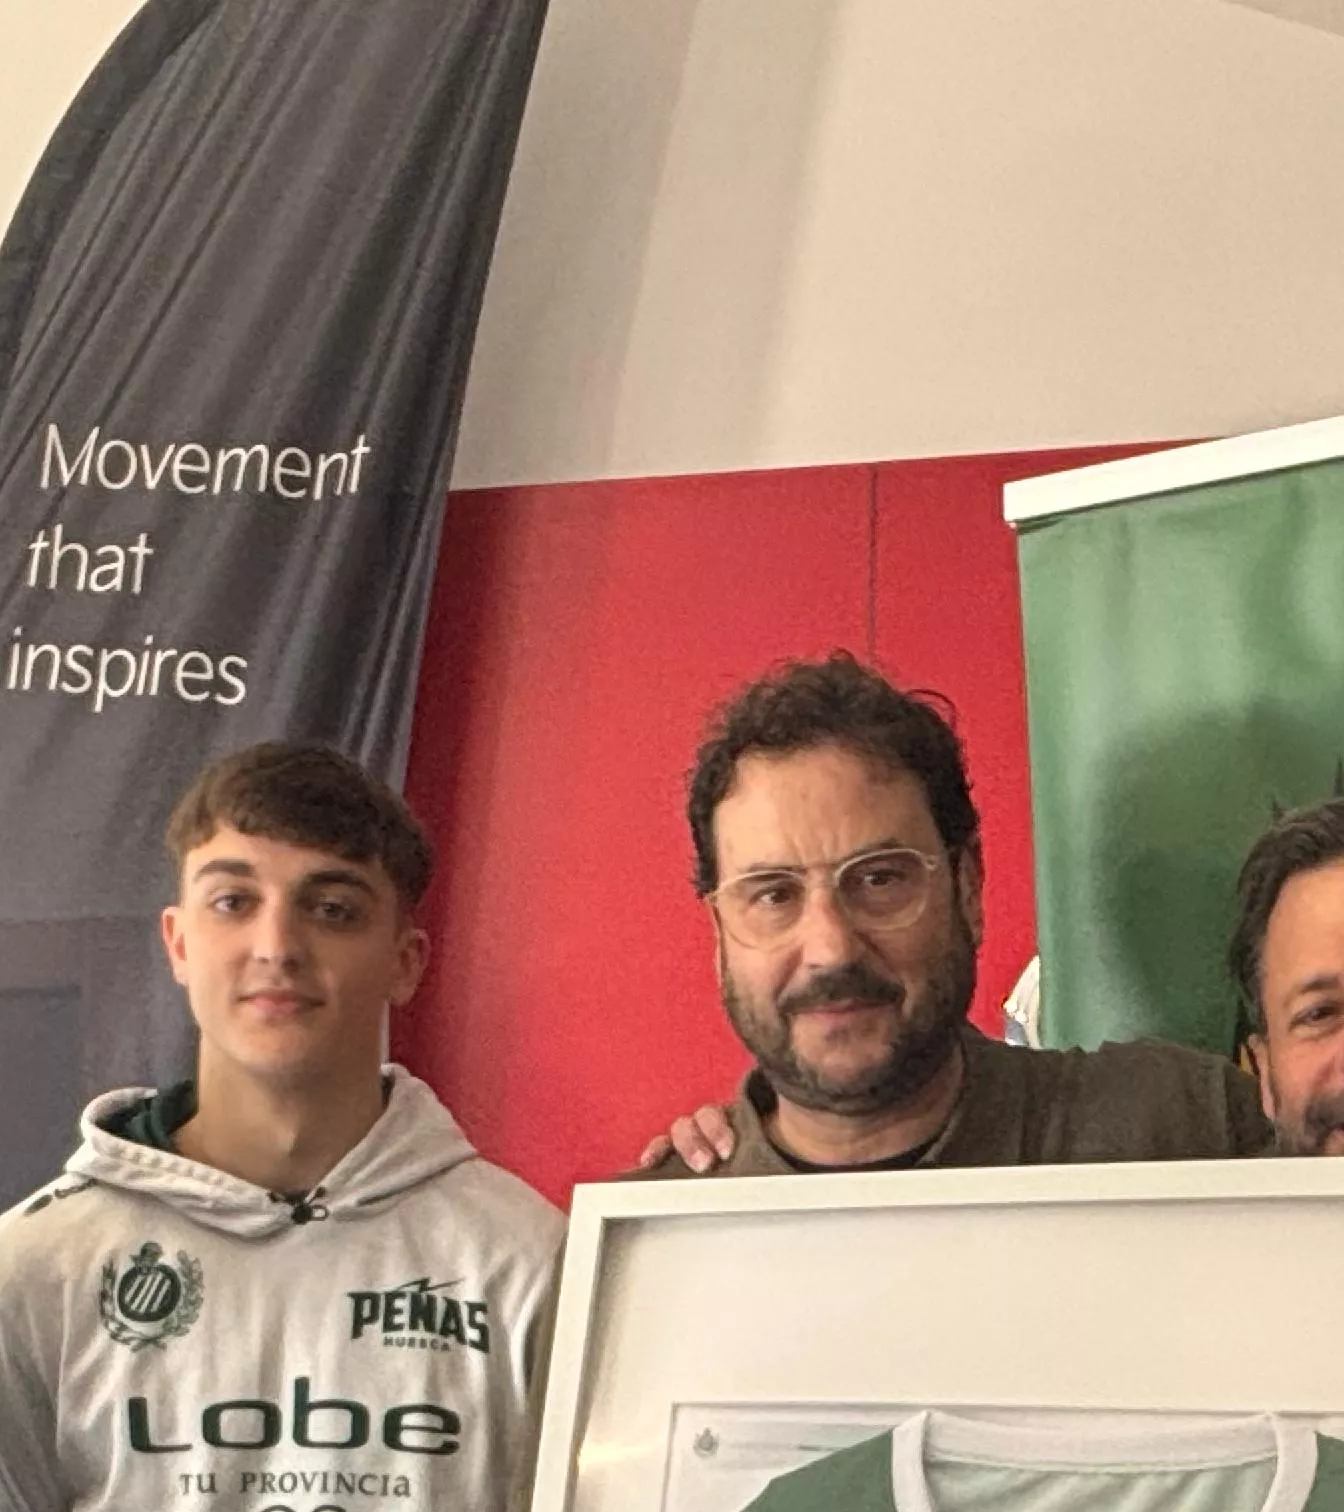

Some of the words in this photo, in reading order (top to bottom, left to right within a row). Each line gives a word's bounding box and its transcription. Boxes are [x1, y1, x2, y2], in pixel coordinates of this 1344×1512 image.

[39, 422, 372, 501] Movement
[26, 523, 155, 594] that
[4, 626, 249, 712] inspires
[127, 1376, 462, 1456] Lobe
